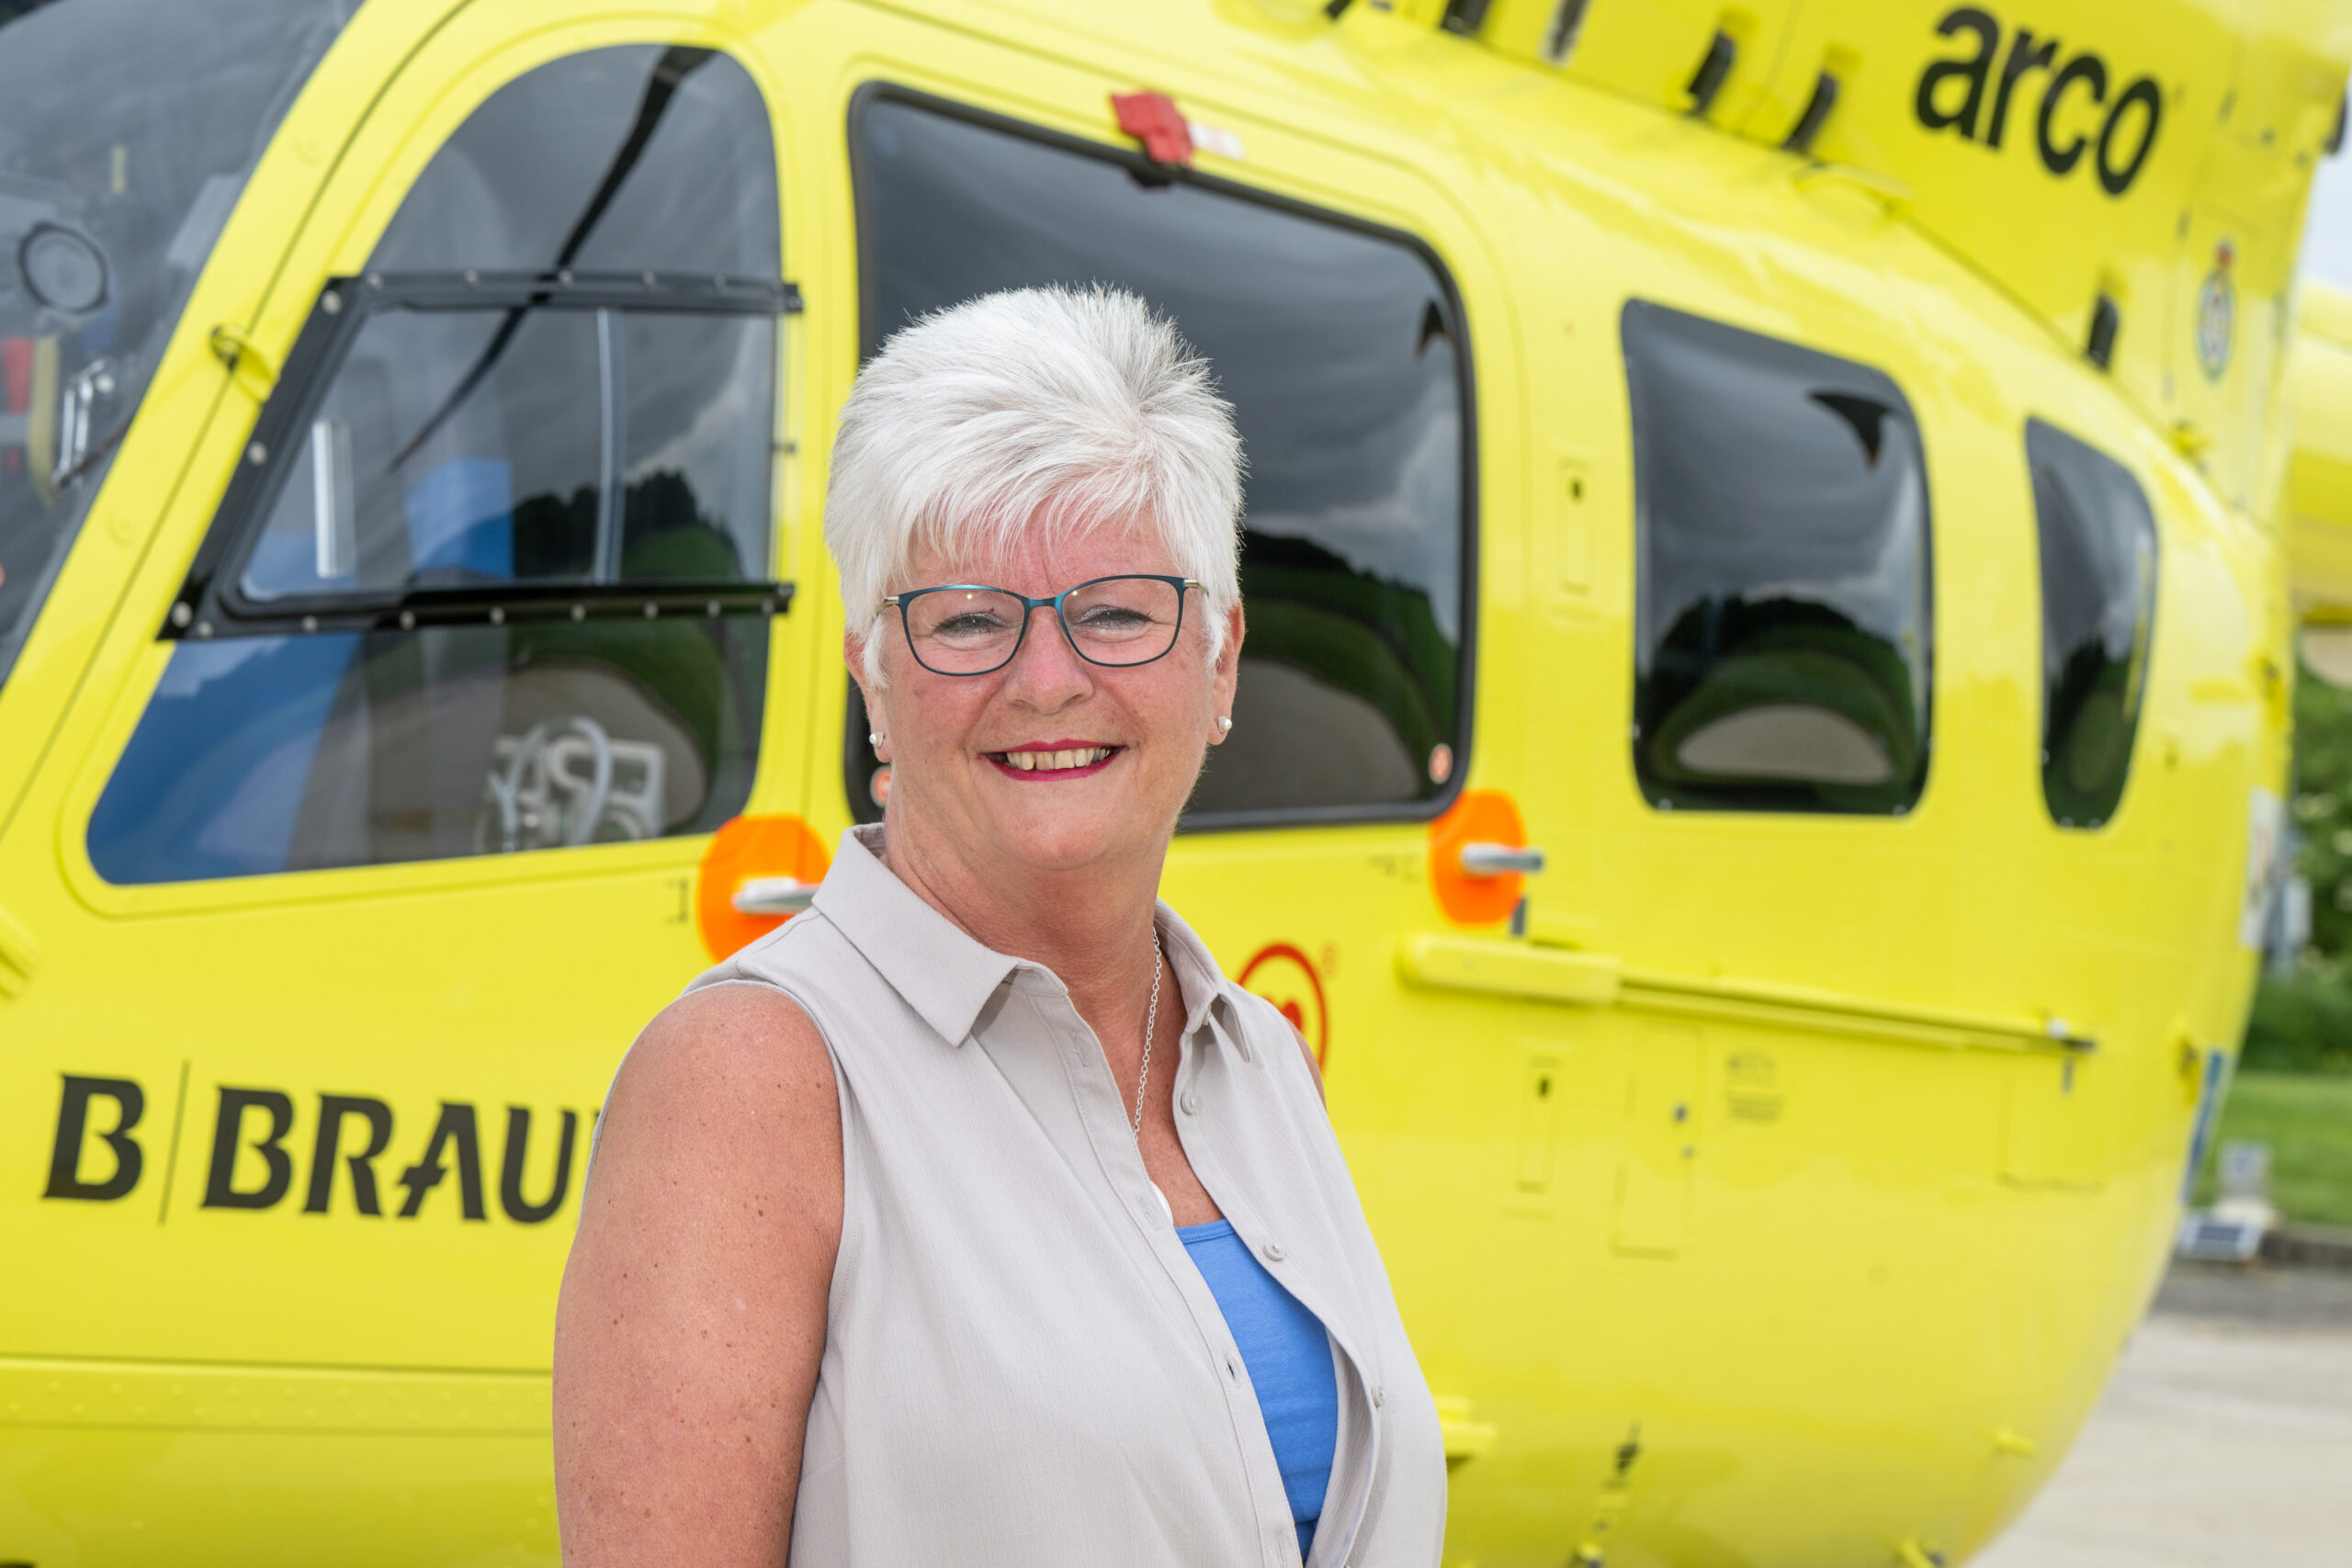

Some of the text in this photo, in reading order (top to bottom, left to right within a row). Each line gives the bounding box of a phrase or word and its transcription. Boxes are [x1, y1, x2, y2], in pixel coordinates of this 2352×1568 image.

[1913, 6, 2165, 197] arco
[42, 1074, 599, 1225] B BRAU
